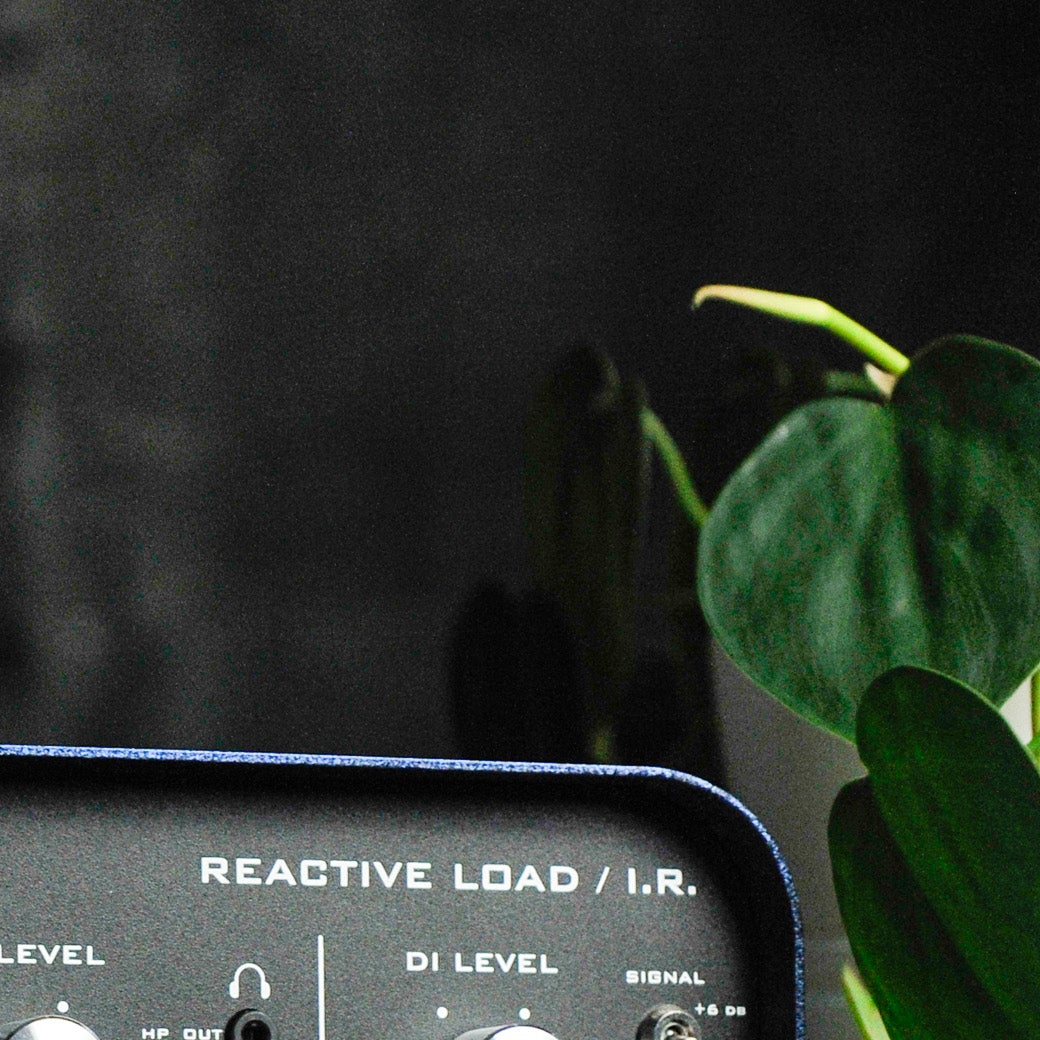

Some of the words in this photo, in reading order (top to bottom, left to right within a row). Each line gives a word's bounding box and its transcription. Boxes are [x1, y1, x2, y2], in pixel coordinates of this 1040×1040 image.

[200, 856, 434, 890] REACTIVE
[453, 863, 580, 894] LOAD
[595, 866, 611, 896] /
[626, 867, 698, 897] I.R.
[406, 951, 440, 973] DI
[454, 952, 560, 975] LEVEL
[625, 969, 706, 986] SIGNAL
[140, 1027, 170, 1040] HP
